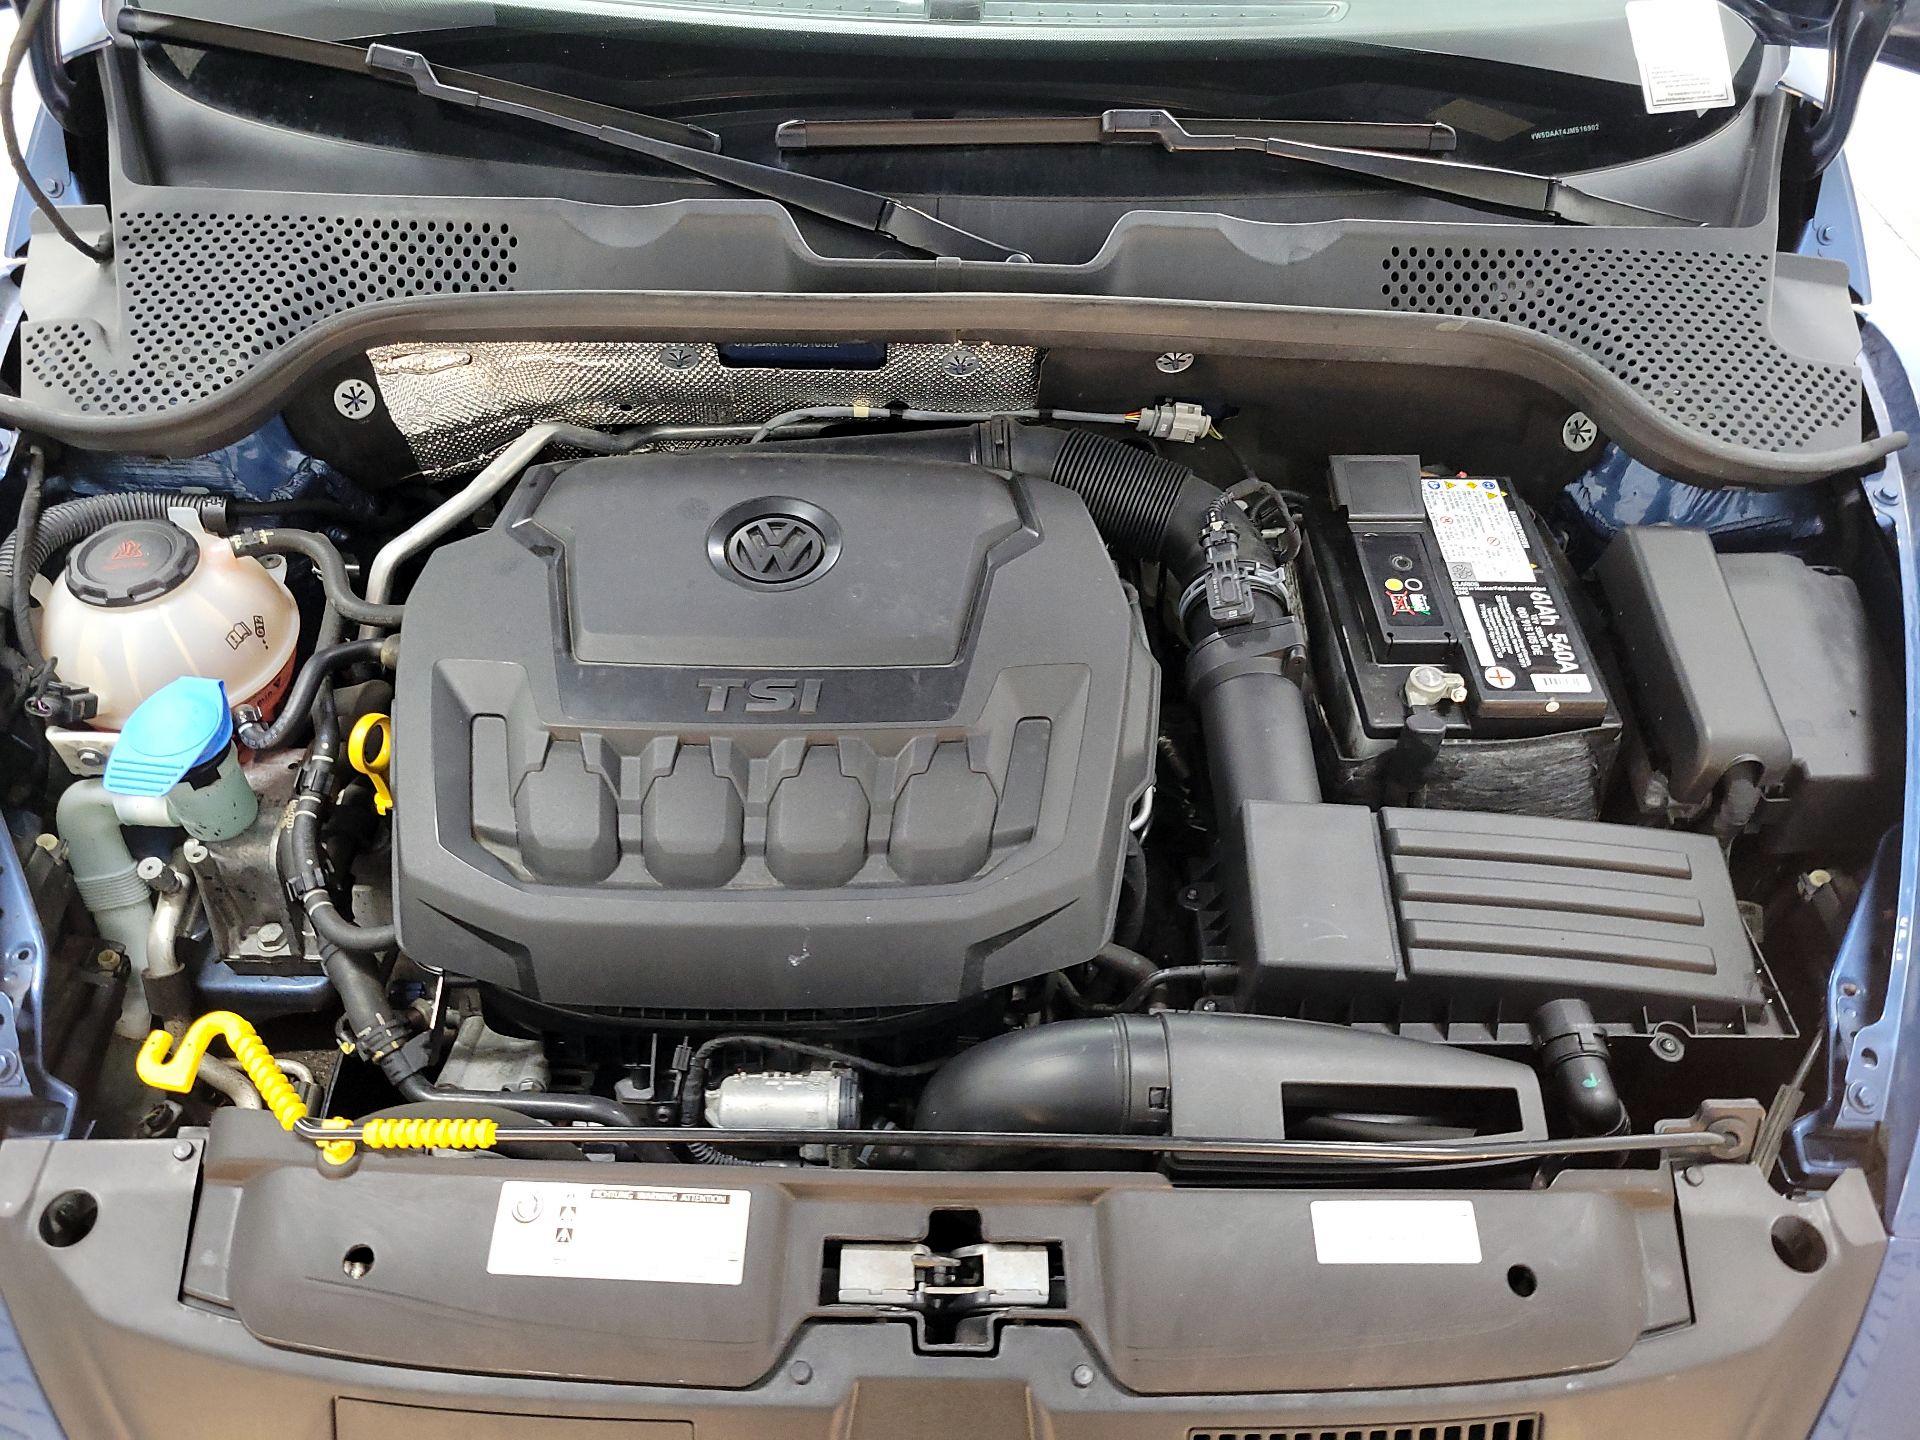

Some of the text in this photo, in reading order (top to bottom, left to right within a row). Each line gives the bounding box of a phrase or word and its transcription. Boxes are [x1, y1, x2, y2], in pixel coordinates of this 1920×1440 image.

[1530, 592, 1579, 673] 61Ah 540A
[697, 678, 824, 715] TSI
[681, 1194, 727, 1204] ATTENTION
